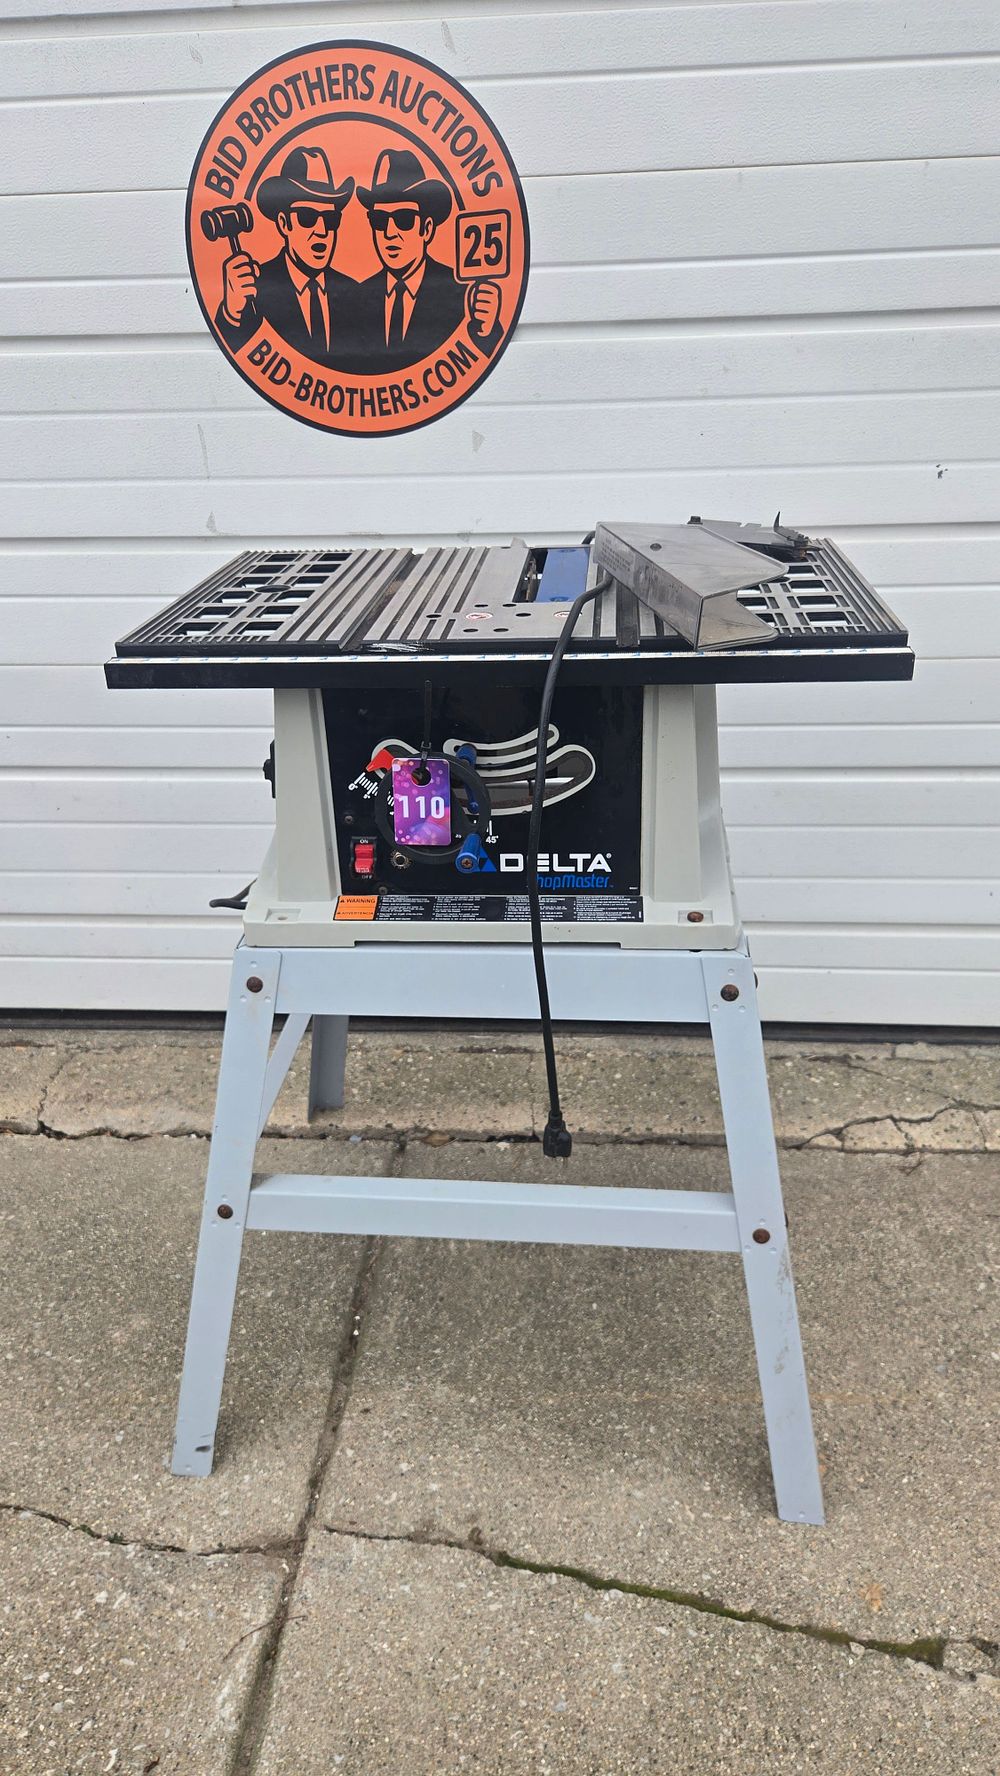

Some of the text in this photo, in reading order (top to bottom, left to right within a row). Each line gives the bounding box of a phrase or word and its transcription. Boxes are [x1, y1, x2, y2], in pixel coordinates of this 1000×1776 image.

[204, 63, 504, 199] BID BROTHERS AUCTIONS
[463, 223, 503, 268] 25
[247, 338, 479, 418] BID-BROTHERS.COM
[398, 795, 445, 819] 110
[536, 873, 610, 891] hopMaster
